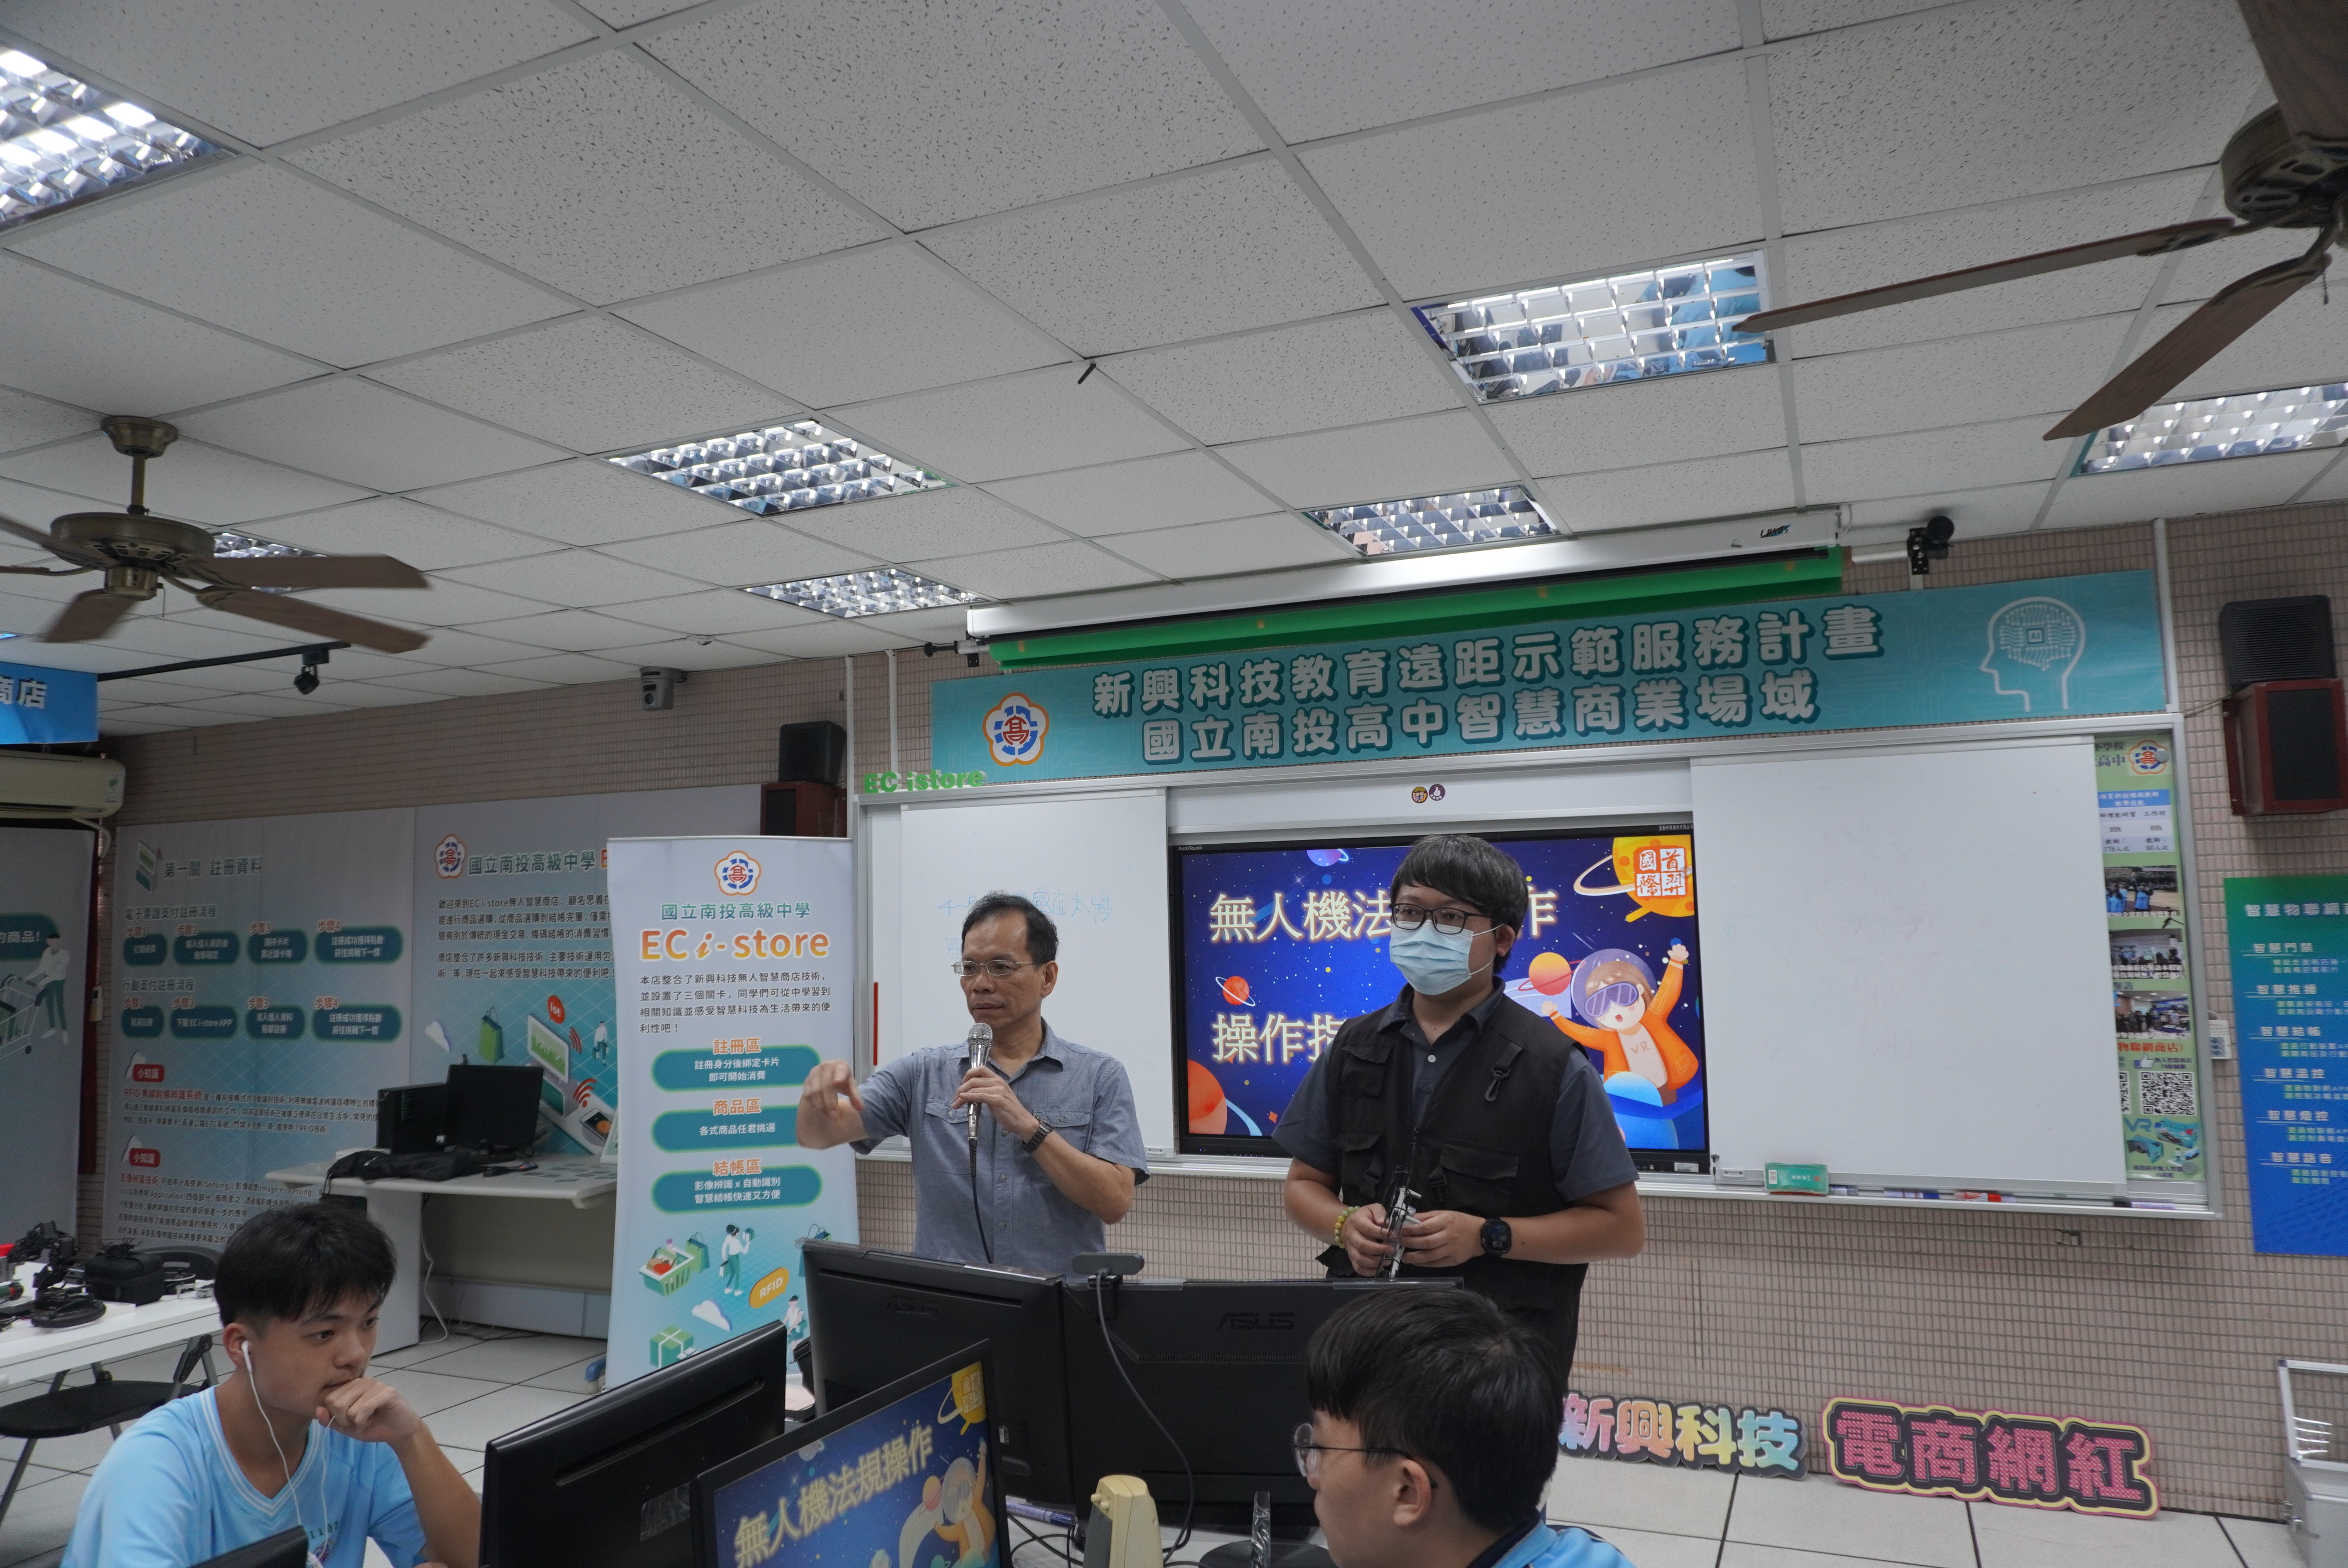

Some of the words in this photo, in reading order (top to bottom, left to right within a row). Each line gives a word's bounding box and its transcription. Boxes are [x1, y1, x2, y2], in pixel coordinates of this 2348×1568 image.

[1093, 605, 1882, 716] 新興科技教育遠距示範服務計畫
[1143, 668, 1818, 764] 國立南投高中智慧商業場域
[864, 771, 900, 794] EC
[907, 770, 987, 791] istore
[468, 850, 595, 875] 國立南投高級中學
[661, 901, 811, 921] 國立南投高級中學
[2245, 902, 2348, 917] 智慧物聯網
[317, 919, 341, 933] 步驟4
[641, 930, 687, 960] EC
[315, 997, 338, 1010] 步驟4
[640, 1002, 830, 1018] 相關知識並感受智慧科技為生活帶來的便
[713, 1038, 761, 1055] 註冊區
[1630, 1041, 1650, 1054] VR
[694, 1058, 779, 1070] 註冊身分後綁定卡片
[708, 1071, 766, 1082] 即可開始消費
[713, 1098, 761, 1116] 商品區
[699, 1122, 775, 1136] 各式商品任君挑選
[713, 1159, 761, 1177] 結帳區
[694, 1179, 733, 1191] 影像辨識
[743, 1177, 780, 1188] 自動識別
[694, 1189, 780, 1204] 智慧結帳快速又方便
[759, 1276, 784, 1299] RFID
[1218, 1312, 1295, 1330] ASUS
[1558, 1392, 1799, 1471] 新興科技
[1836, 1410, 2142, 1503] 電商網紅
[734, 1426, 934, 1568] 無人機法規操作
